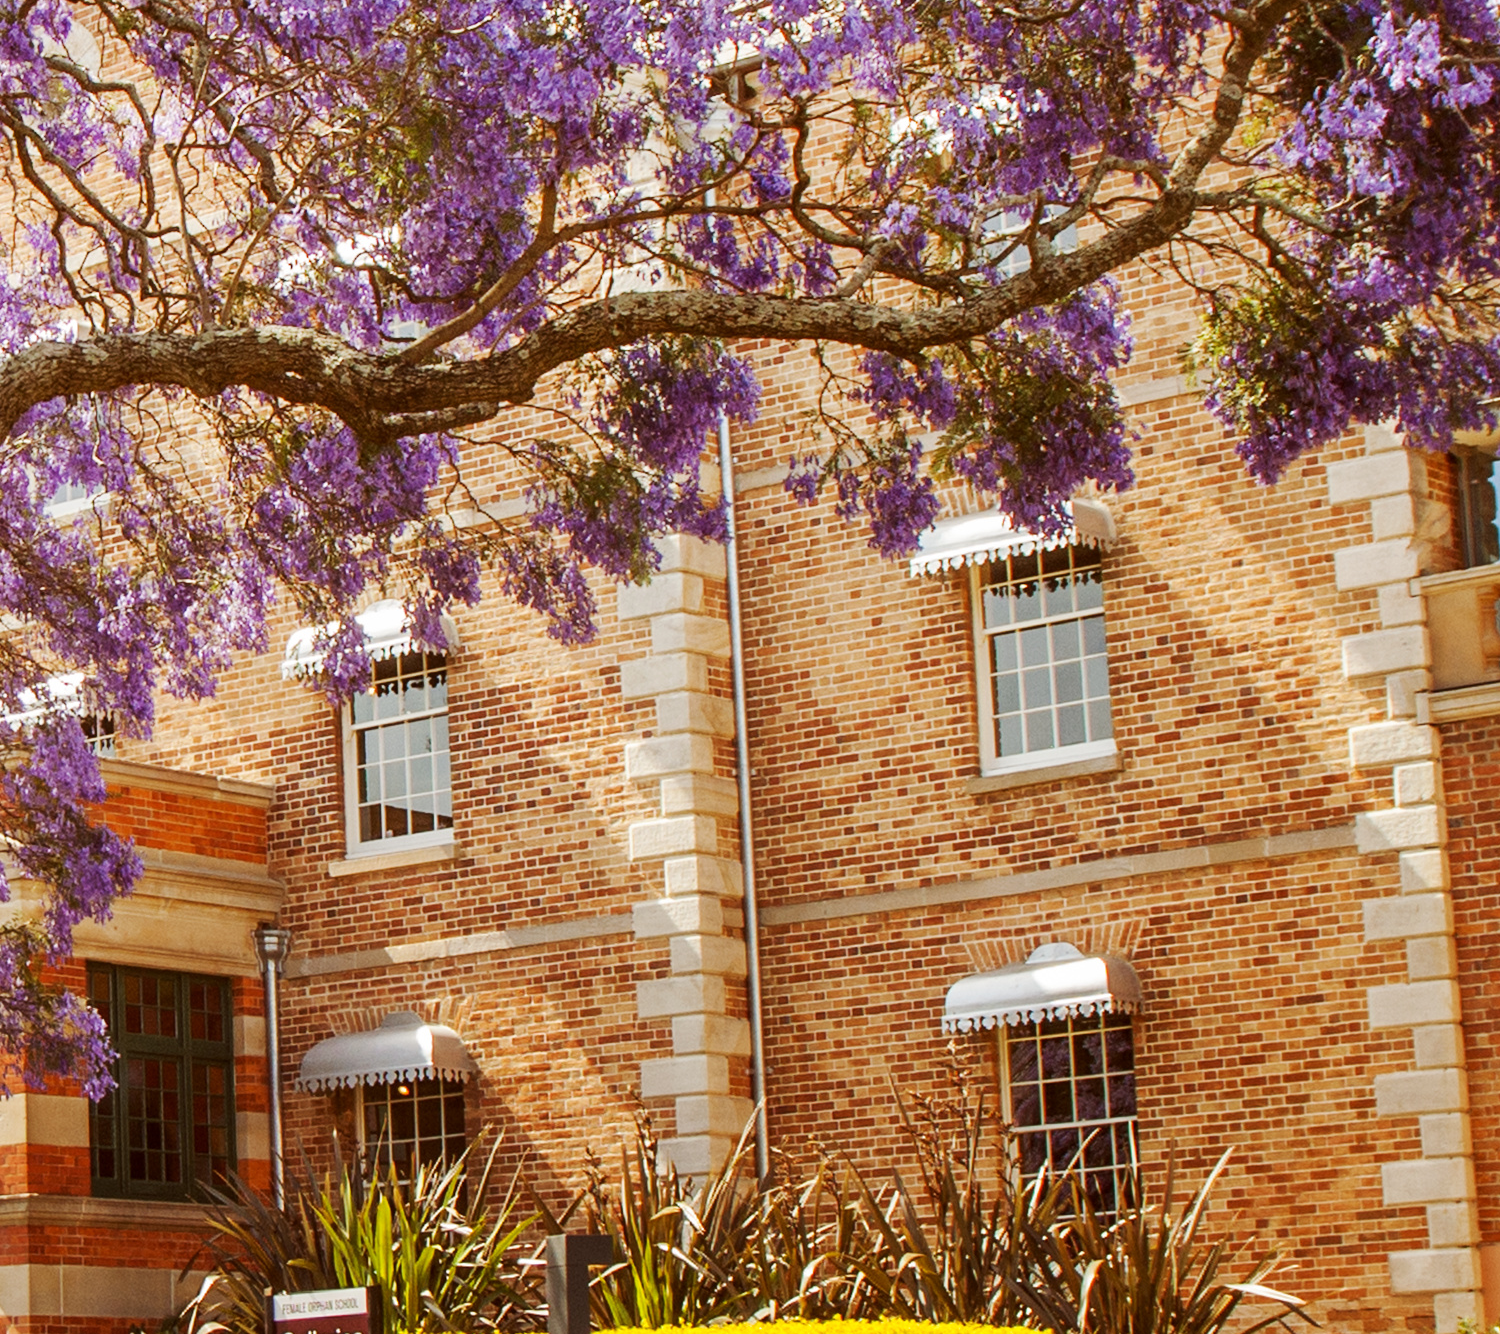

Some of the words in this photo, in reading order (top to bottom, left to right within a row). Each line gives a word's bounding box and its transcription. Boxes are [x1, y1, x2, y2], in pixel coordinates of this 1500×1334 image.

[282, 1302, 306, 1315] FEMALE
[308, 1300, 333, 1312] ORPHAN
[335, 1298, 359, 1310] SCHOOL
